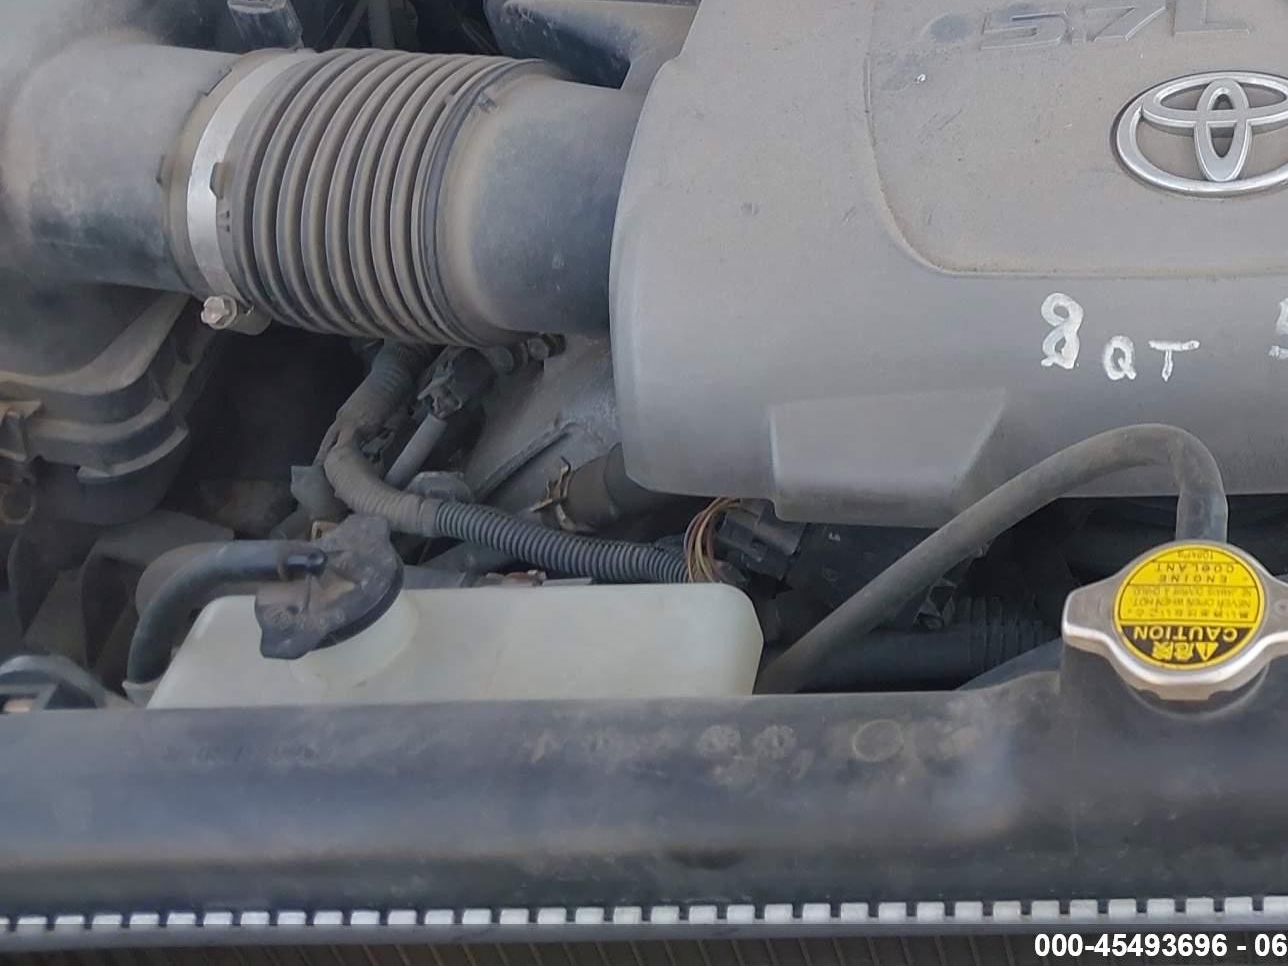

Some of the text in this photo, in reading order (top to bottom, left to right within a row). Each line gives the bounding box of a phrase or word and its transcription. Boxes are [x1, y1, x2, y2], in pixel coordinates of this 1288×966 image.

[1040, 292, 1084, 370] 8
[1103, 335, 1200, 382] QT
[1156, 564, 1234, 573] COOLANT
[1159, 574, 1228, 583] ENGINE
[1134, 626, 1238, 642] CAUTION
